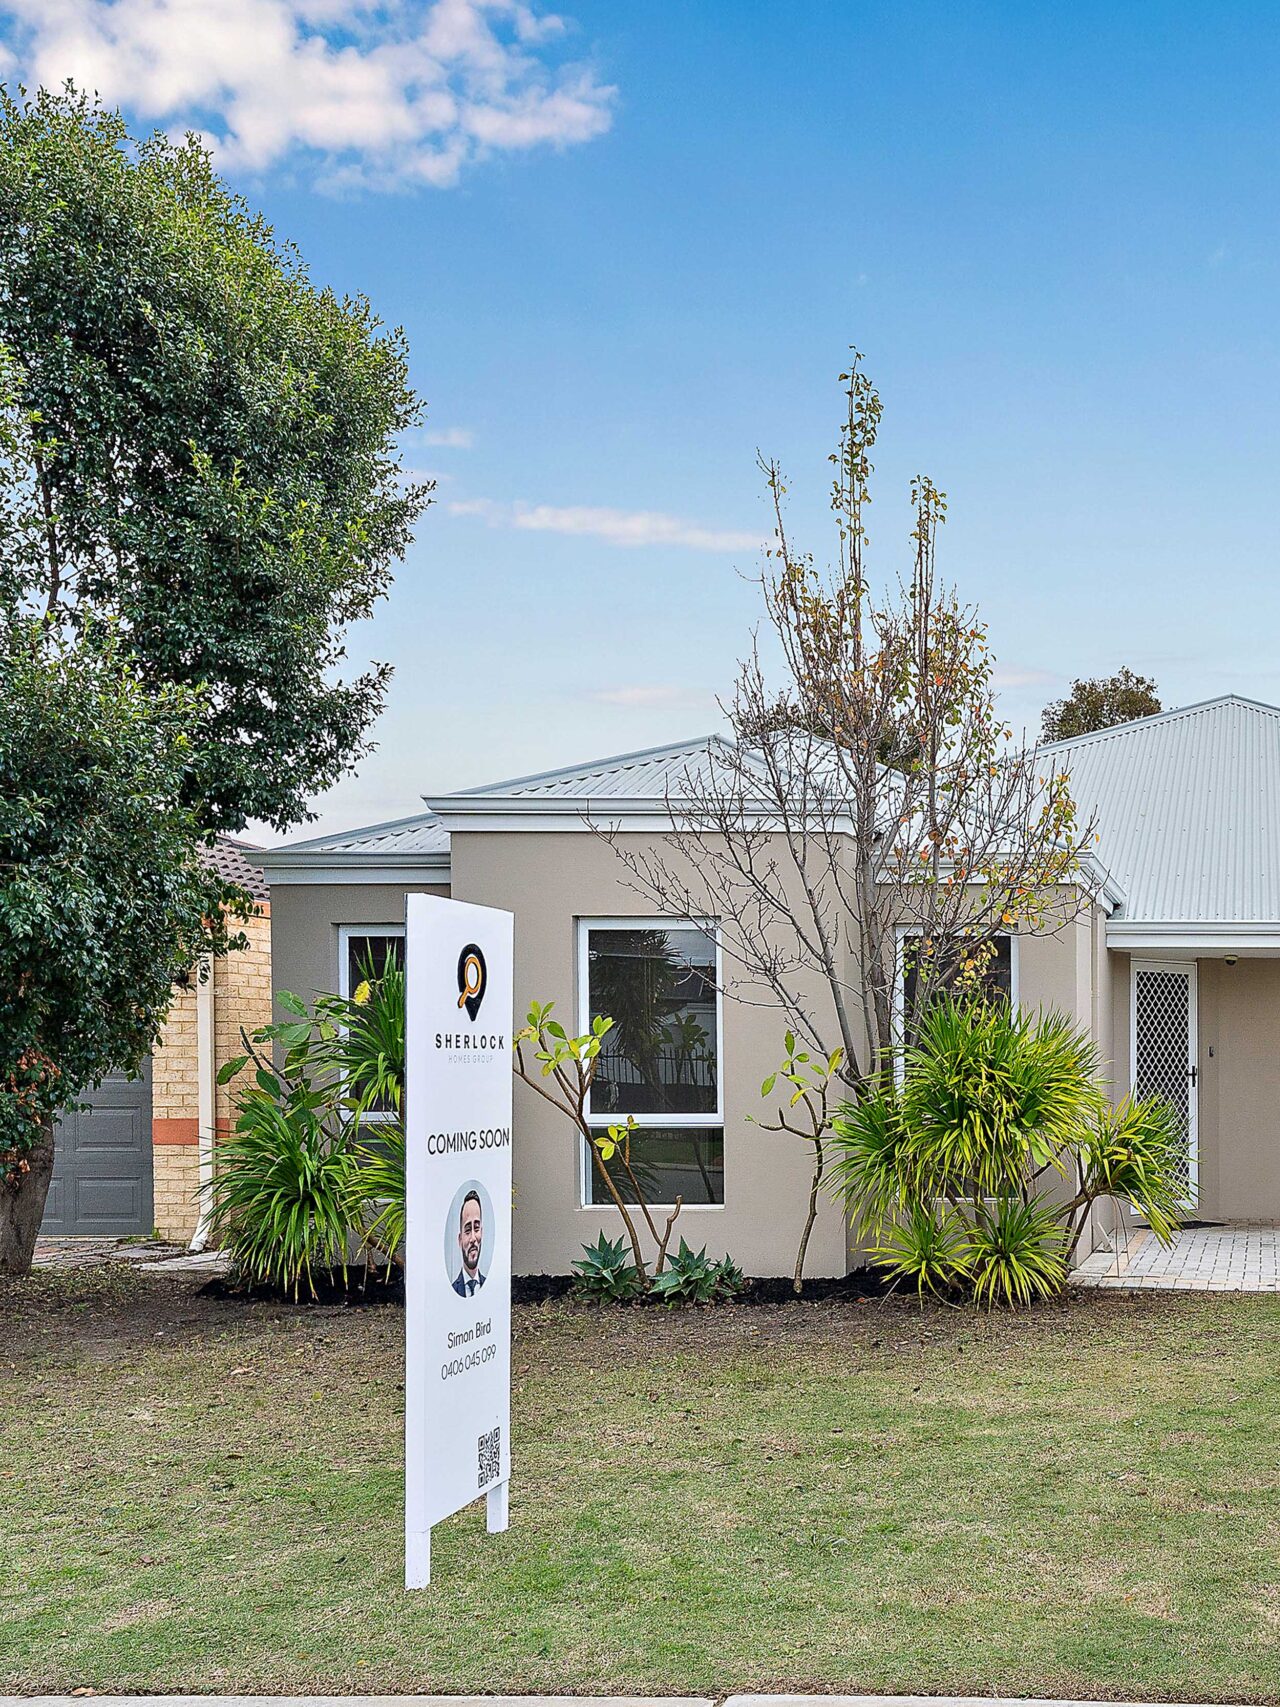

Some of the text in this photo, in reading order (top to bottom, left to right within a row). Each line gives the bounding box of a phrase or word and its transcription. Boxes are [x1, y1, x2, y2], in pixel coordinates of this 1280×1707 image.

[435, 1033, 504, 1050] SHERLOCK
[448, 1054, 493, 1064] HOMES GROUP
[427, 1127, 510, 1155] COMING SOON
[447, 1317, 492, 1349] Simon Bird
[441, 1344, 497, 1380] 0406 045 099
